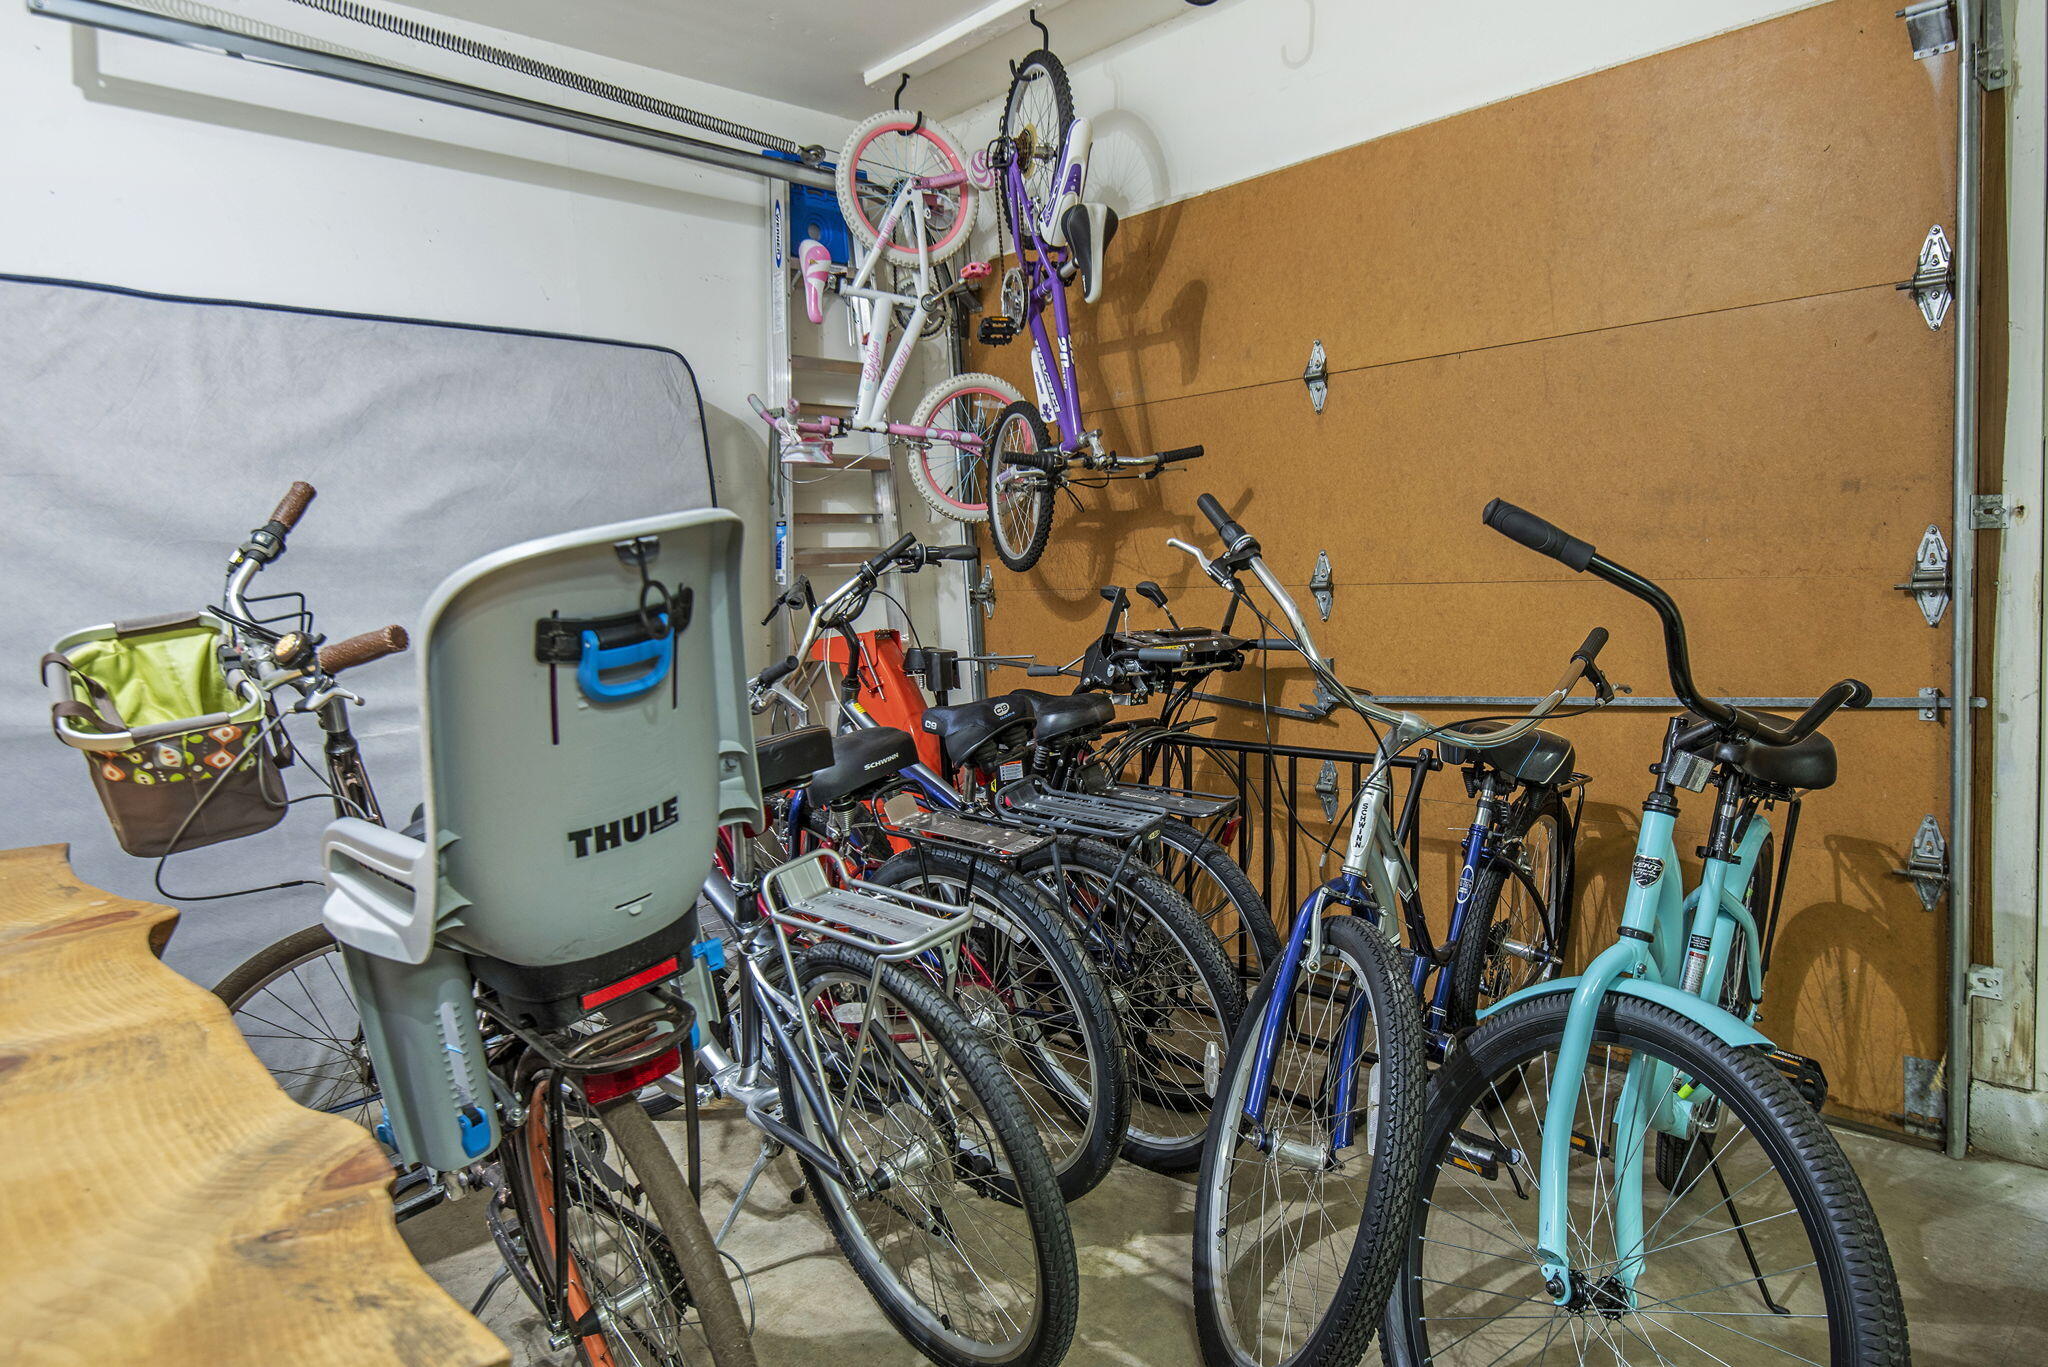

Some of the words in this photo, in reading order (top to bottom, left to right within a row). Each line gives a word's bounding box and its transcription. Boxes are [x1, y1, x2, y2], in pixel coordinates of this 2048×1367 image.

[994, 703, 1009, 714] C9
[924, 720, 938, 730] C9
[864, 752, 899, 770] SCHWINN
[568, 796, 679, 858] THULE
[1354, 802, 1369, 848] SCHWINN
